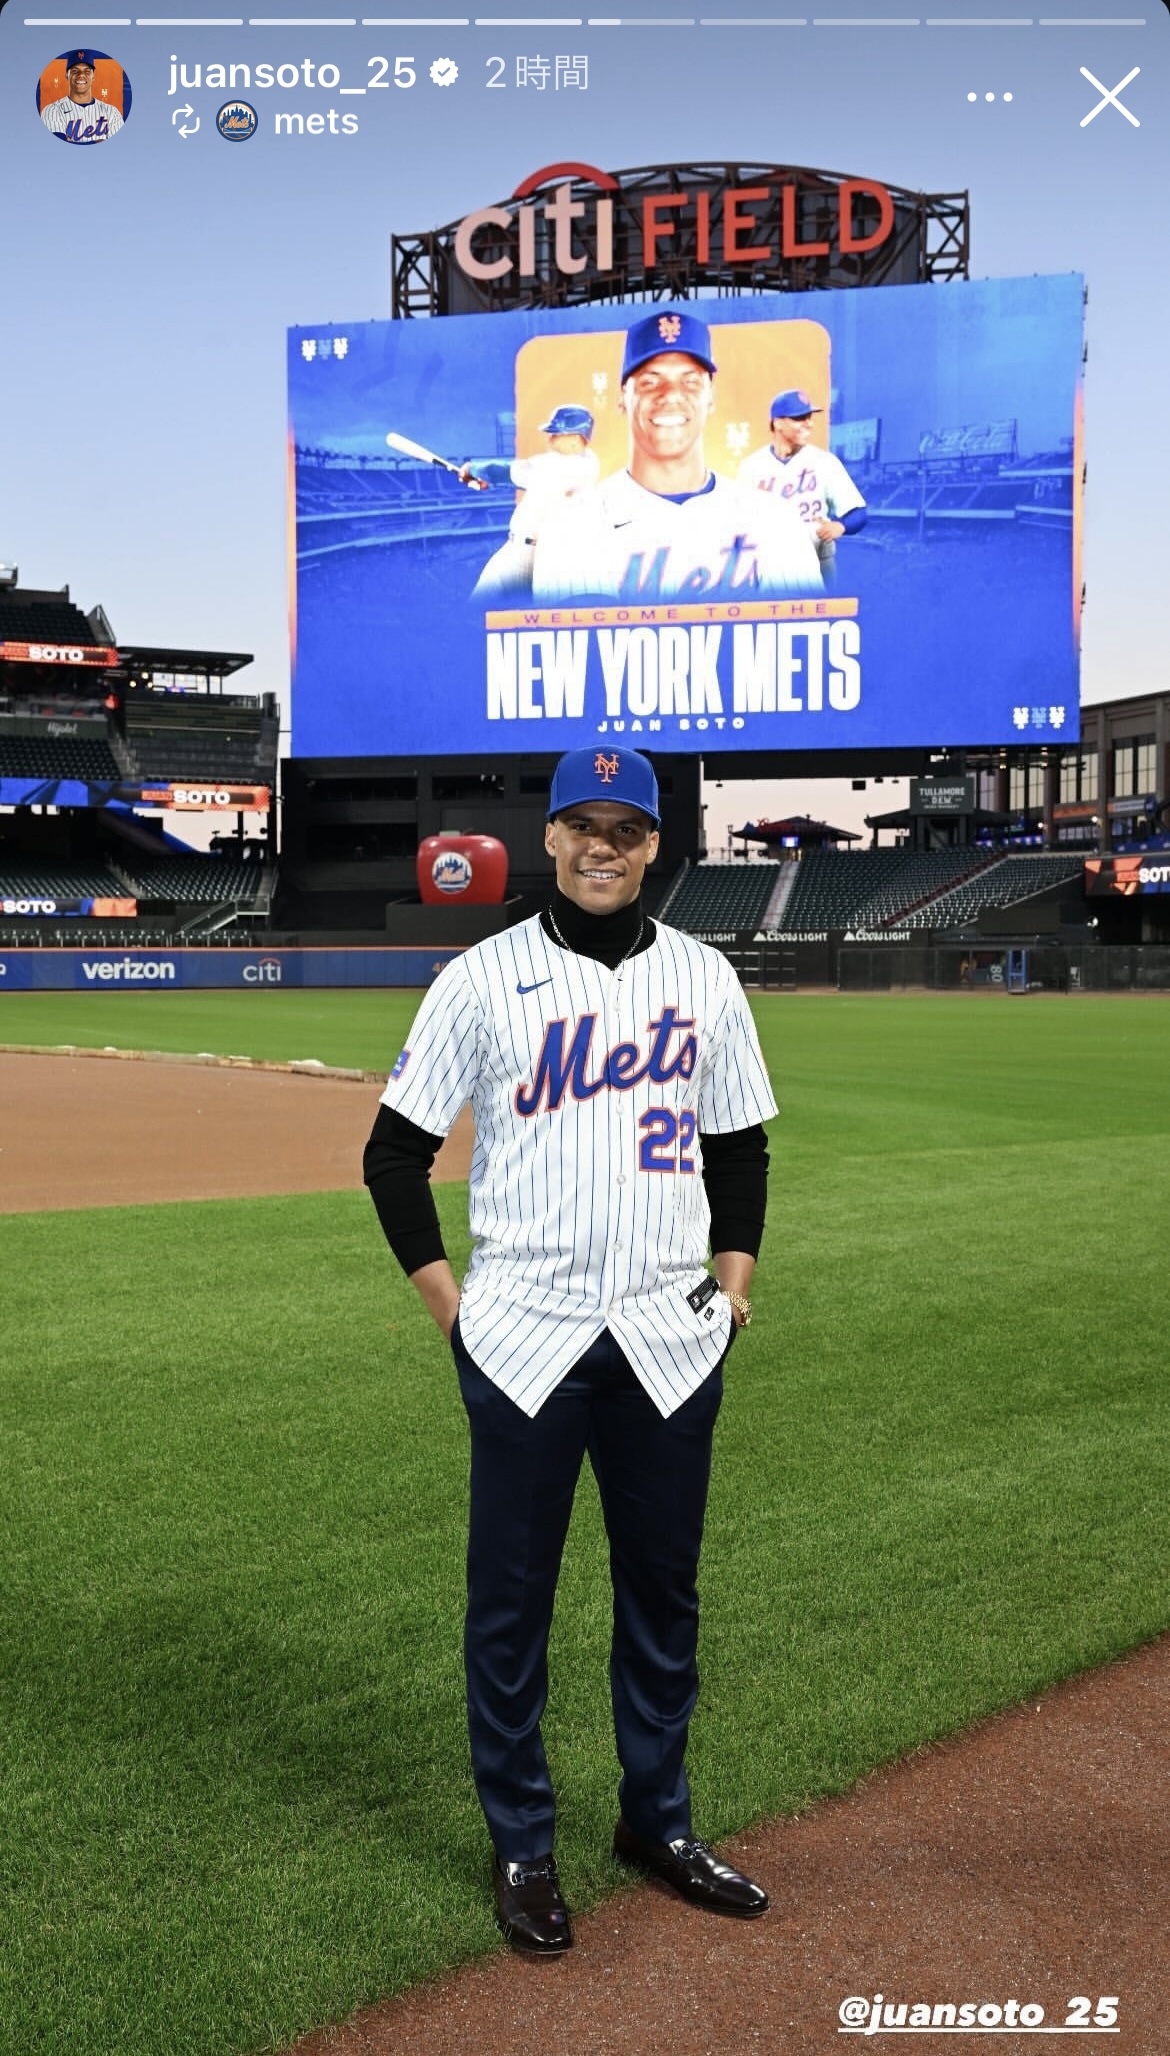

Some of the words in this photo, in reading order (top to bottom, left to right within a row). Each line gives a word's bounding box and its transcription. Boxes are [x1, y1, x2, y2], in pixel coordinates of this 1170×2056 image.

[643, 179, 895, 269] FIELD
[523, 609, 678, 624] WELCOME
[706, 605, 741, 618] TO
[769, 602, 827, 615] THE
[28, 646, 84, 662] SOTO
[486, 629, 589, 720] NEW
[596, 625, 724, 716] YORK
[733, 620, 861, 714] METS
[597, 719, 662, 732] JUAN
[679, 717, 745, 731] SOTO
[173, 790, 231, 805] SOTO
[919, 787, 966, 796] TULLAMORE
[1139, 866, 1170, 884] SOT
[3, 900, 56, 914] SOTO
[707, 932, 737, 943] LIGHT
[799, 932, 828, 942] LIGHT
[884, 931, 911, 941] LIGHT
[82, 957, 175, 980] verizon
[242, 963, 281, 982] citi
[514, 1006, 699, 1118] Mets
